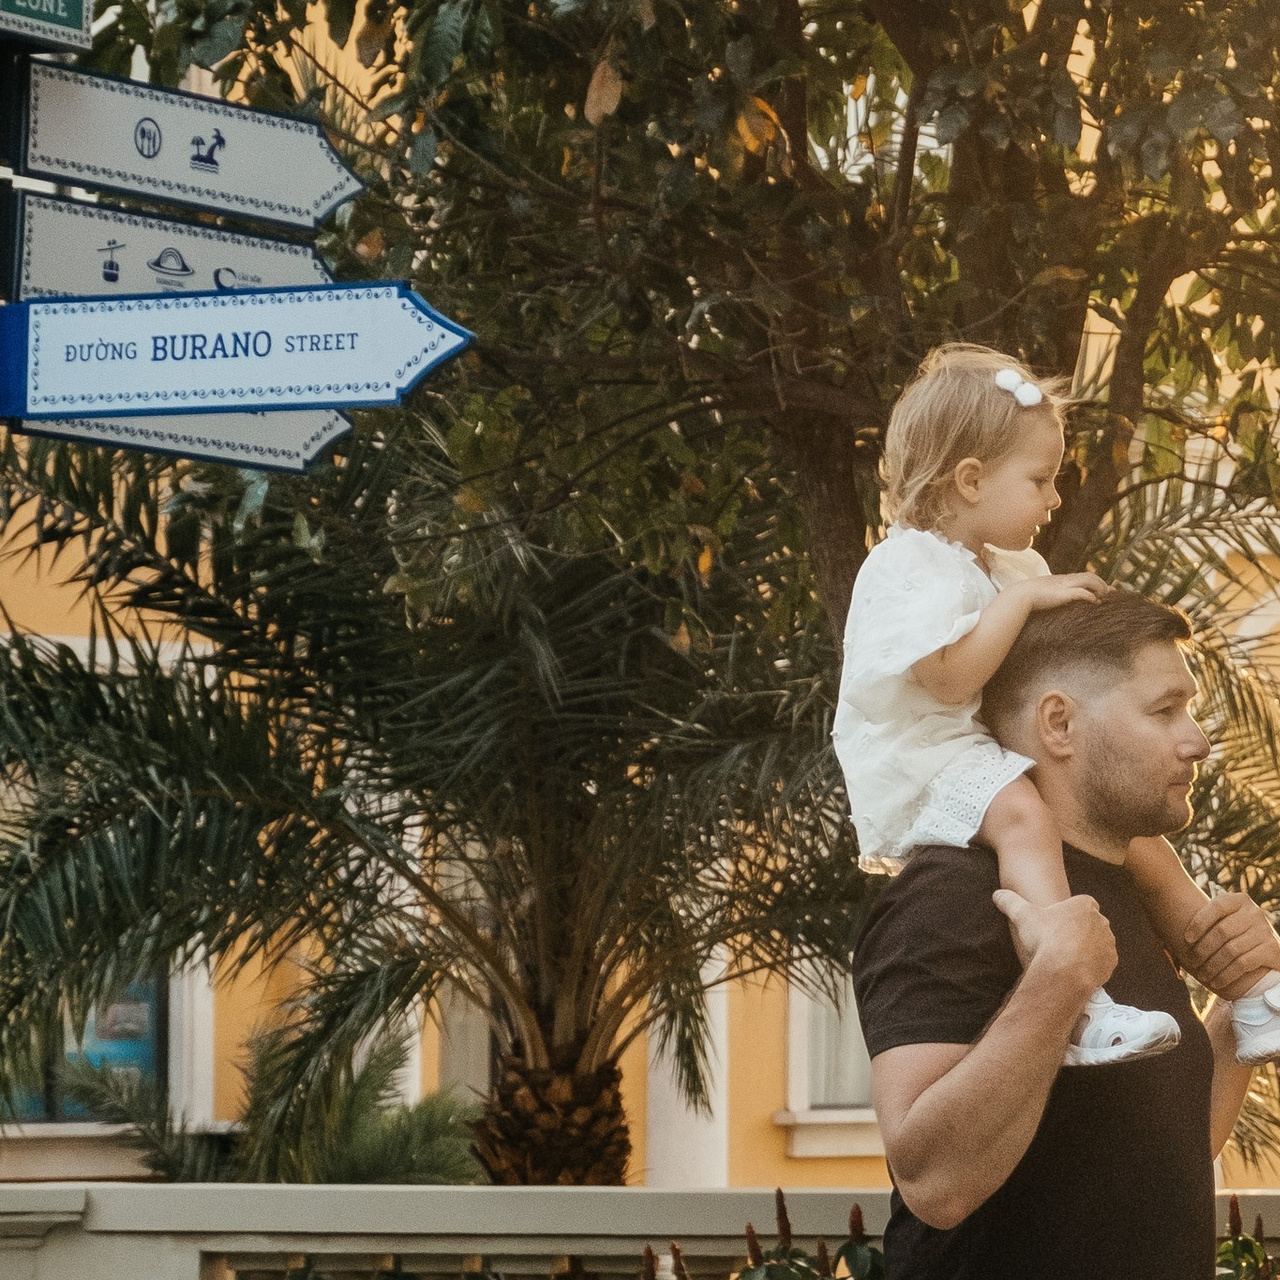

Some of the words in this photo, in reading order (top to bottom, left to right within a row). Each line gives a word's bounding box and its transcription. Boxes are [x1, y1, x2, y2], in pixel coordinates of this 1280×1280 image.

[65, 337, 137, 362] ĐƯỜNG
[151, 330, 272, 361] BURANO
[285, 332, 358, 353] STREET
